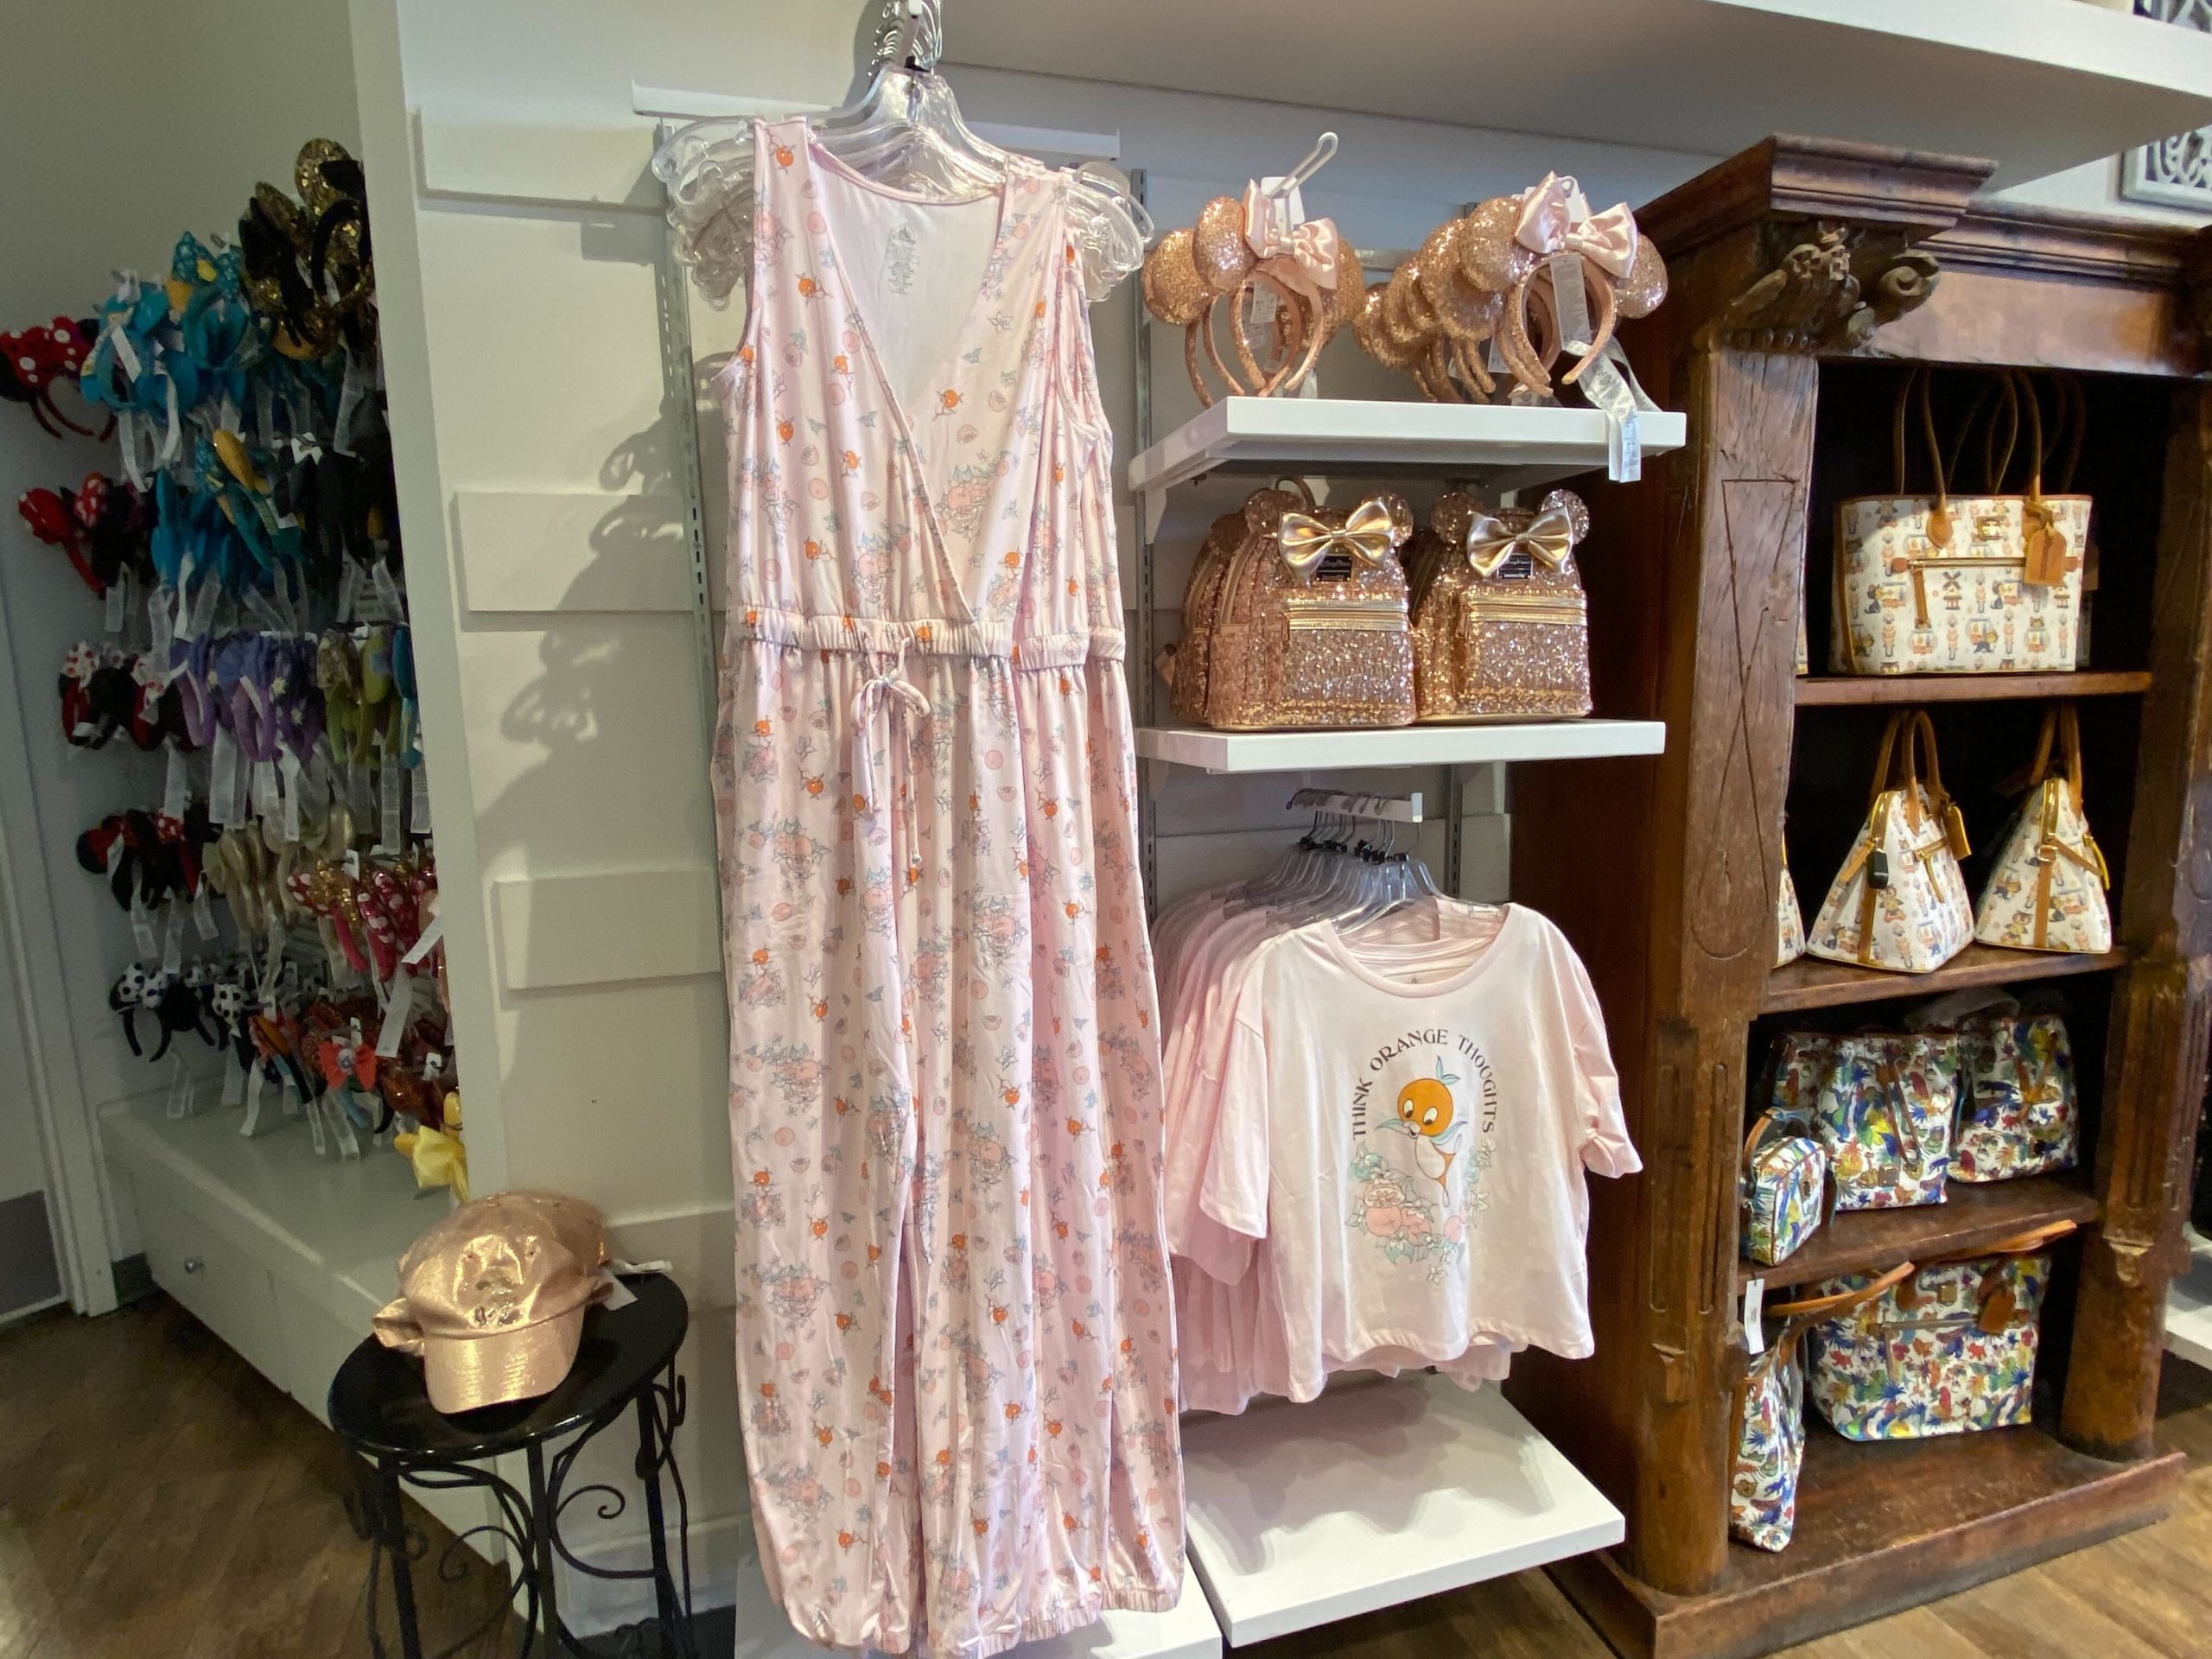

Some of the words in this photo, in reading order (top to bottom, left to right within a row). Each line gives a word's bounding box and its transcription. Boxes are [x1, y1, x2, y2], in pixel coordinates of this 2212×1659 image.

[1352, 1077, 1373, 1141] THINK
[1370, 1029, 1448, 1071] ORANGE
[1459, 1034, 1497, 1133] THOUGHTS
